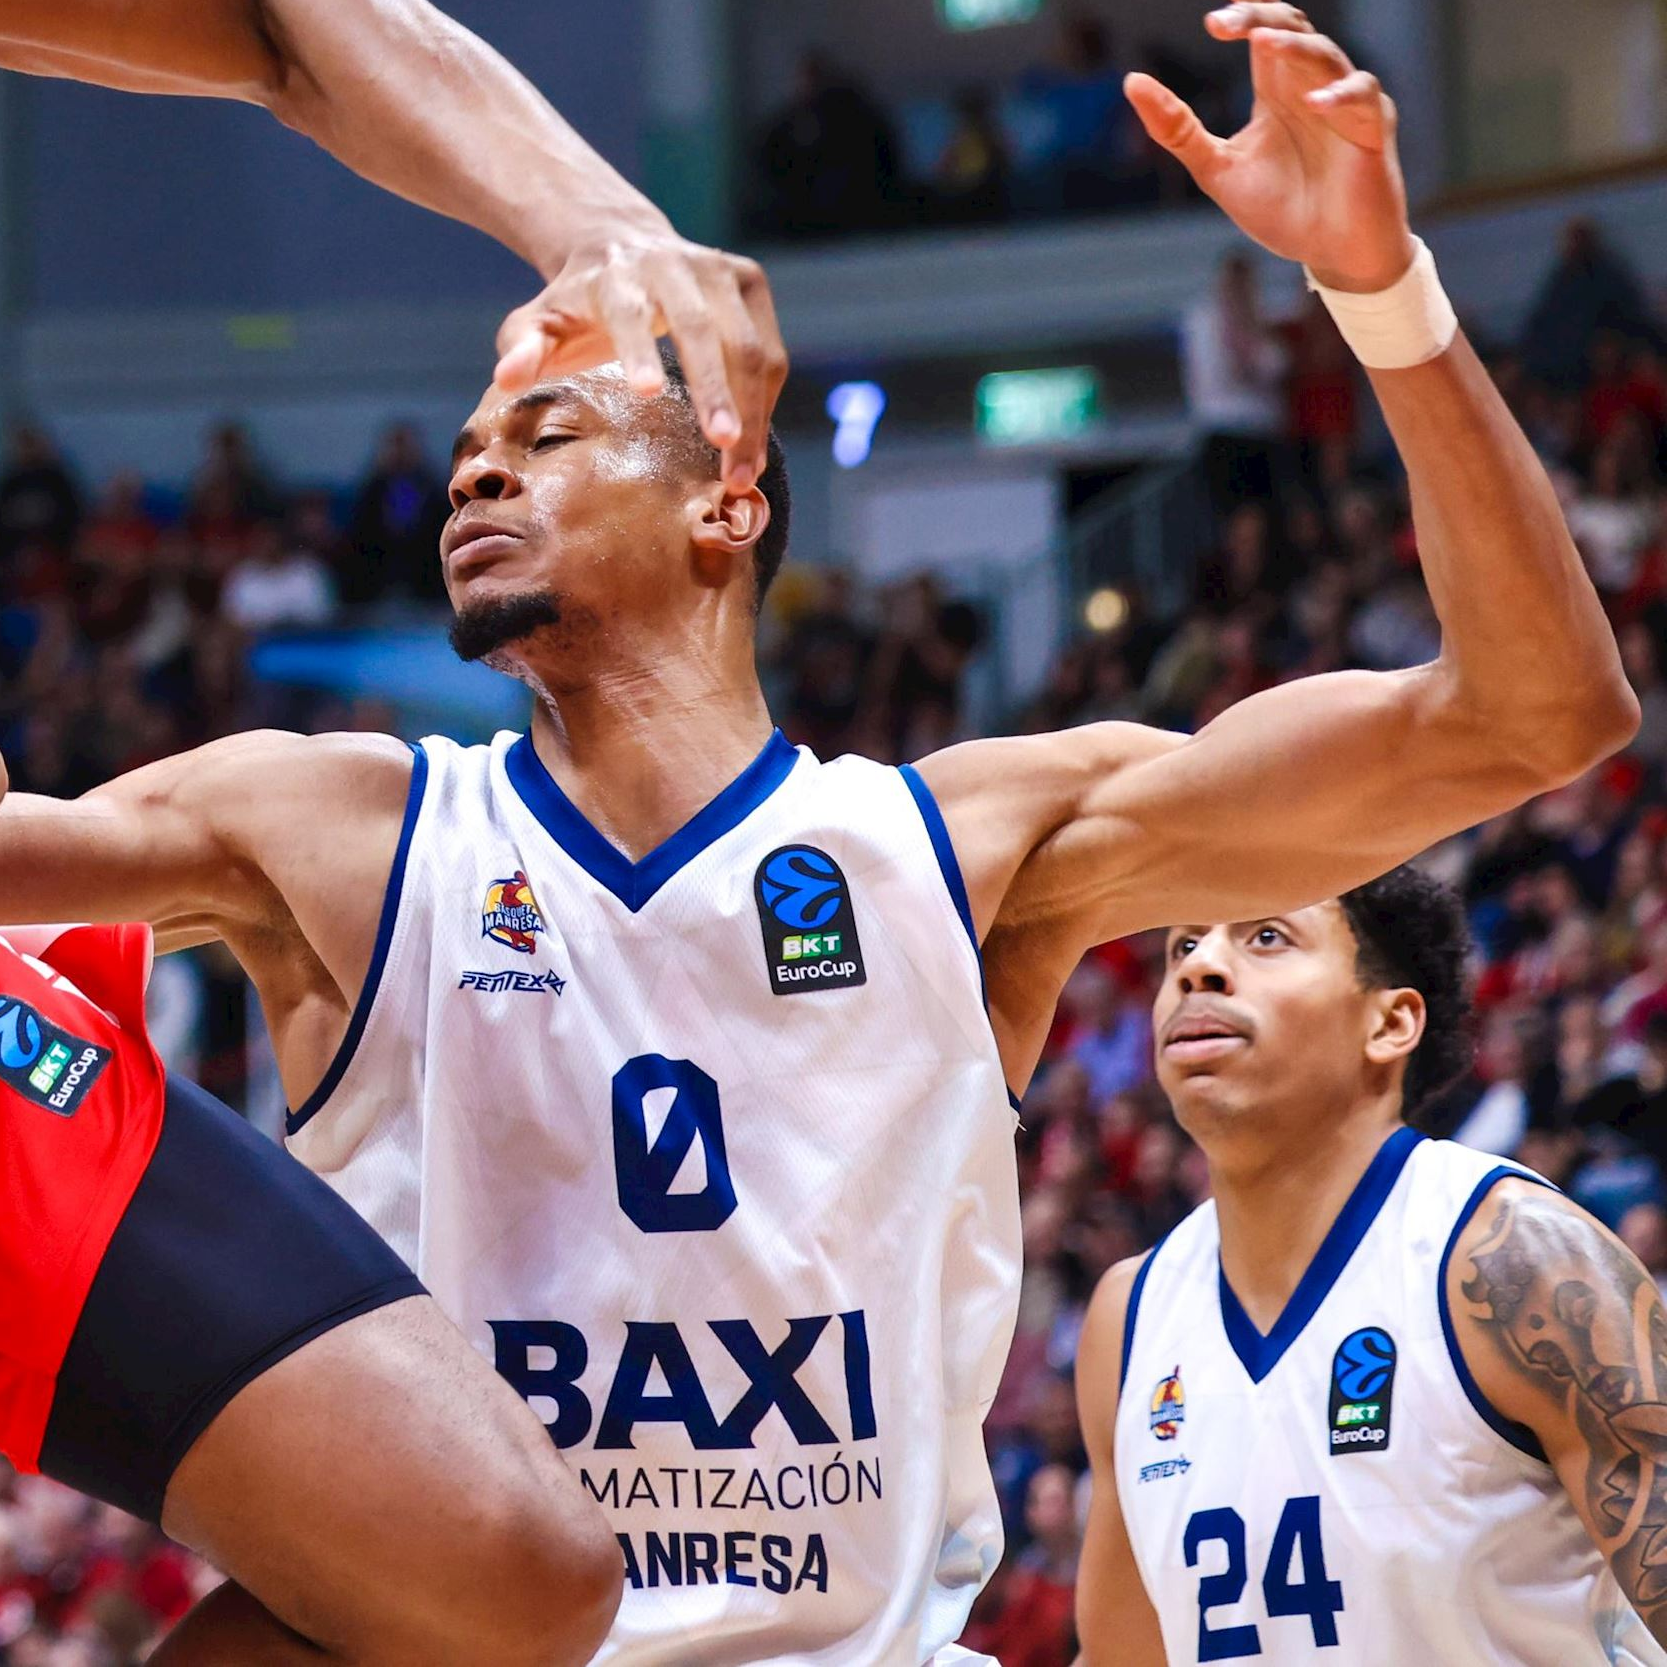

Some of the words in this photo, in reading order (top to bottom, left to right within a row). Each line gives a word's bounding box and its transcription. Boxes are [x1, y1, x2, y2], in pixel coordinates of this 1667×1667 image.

[484, 913, 543, 932] MANRESA
[783, 934, 840, 957] BKT
[776, 960, 857, 983] EuroCup
[30, 1041, 70, 1092] BKT
[48, 1046, 99, 1108] EuroCup
[612, 1053, 738, 1233] 0
[484, 1309, 877, 1450] BAXI
[1331, 1427, 1385, 1445] EuroCup
[1336, 1404, 1380, 1425] BKT
[581, 1451, 882, 1511] MATIZACIÓN
[615, 1531, 828, 1594] ANRESA
[1183, 1495, 1345, 1663] 24
